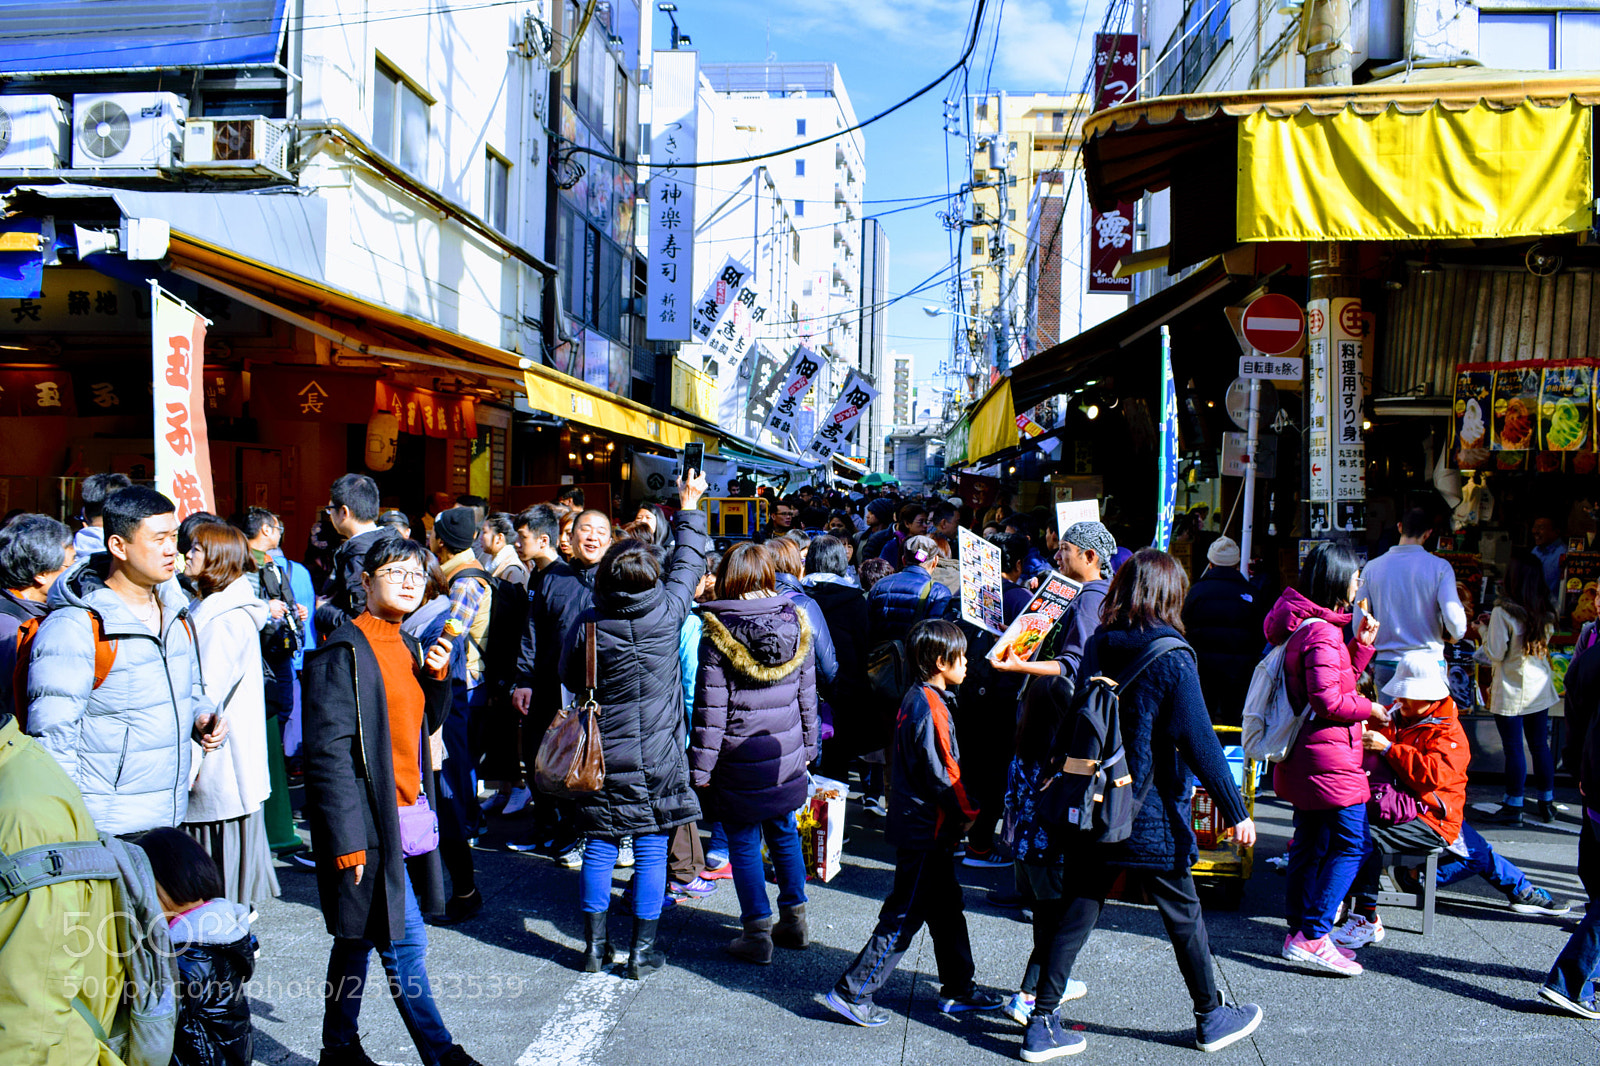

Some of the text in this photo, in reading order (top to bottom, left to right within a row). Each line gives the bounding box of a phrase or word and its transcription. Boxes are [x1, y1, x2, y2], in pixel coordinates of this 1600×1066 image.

[1096, 277, 1130, 285] SHOURO
[1243, 361, 1299, 377] 自転車を除く
[1341, 343, 1357, 442] 料理用すり身
[1340, 474, 1358, 483] ここ
